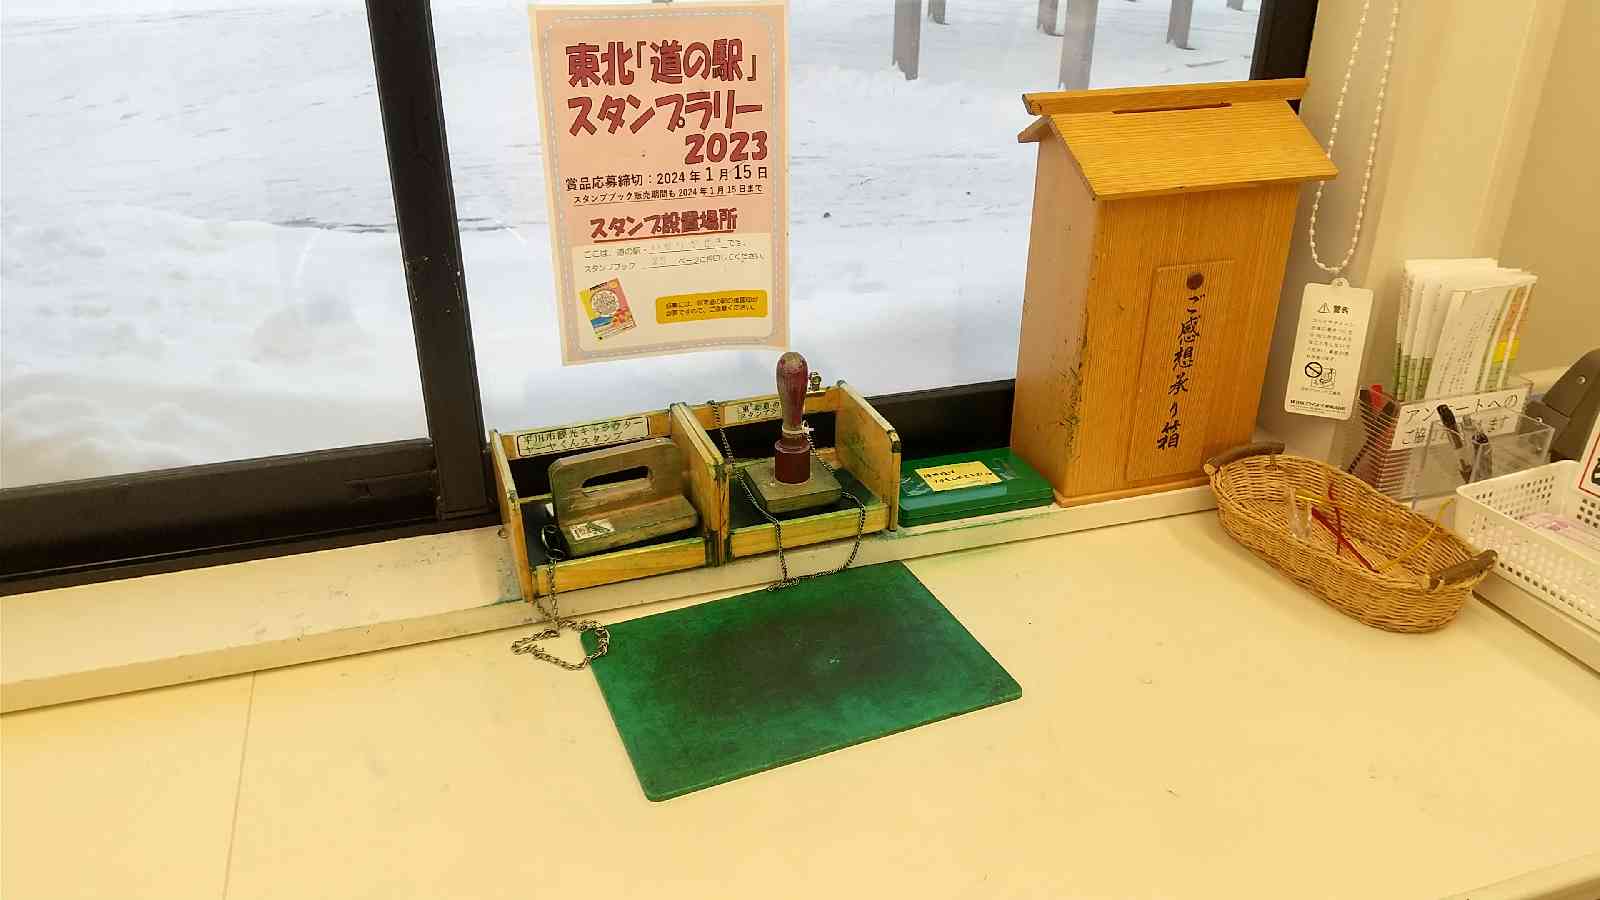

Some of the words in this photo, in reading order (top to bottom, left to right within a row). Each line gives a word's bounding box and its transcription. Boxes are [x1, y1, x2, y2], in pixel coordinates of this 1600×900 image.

[565, 38, 757, 87] 東北「道の駅」
[567, 89, 763, 136] スタンプラリー
[685, 130, 768, 165] 2023
[590, 207, 738, 238] スタンプ設置場所
[1406, 394, 1518, 423] アンートへの
